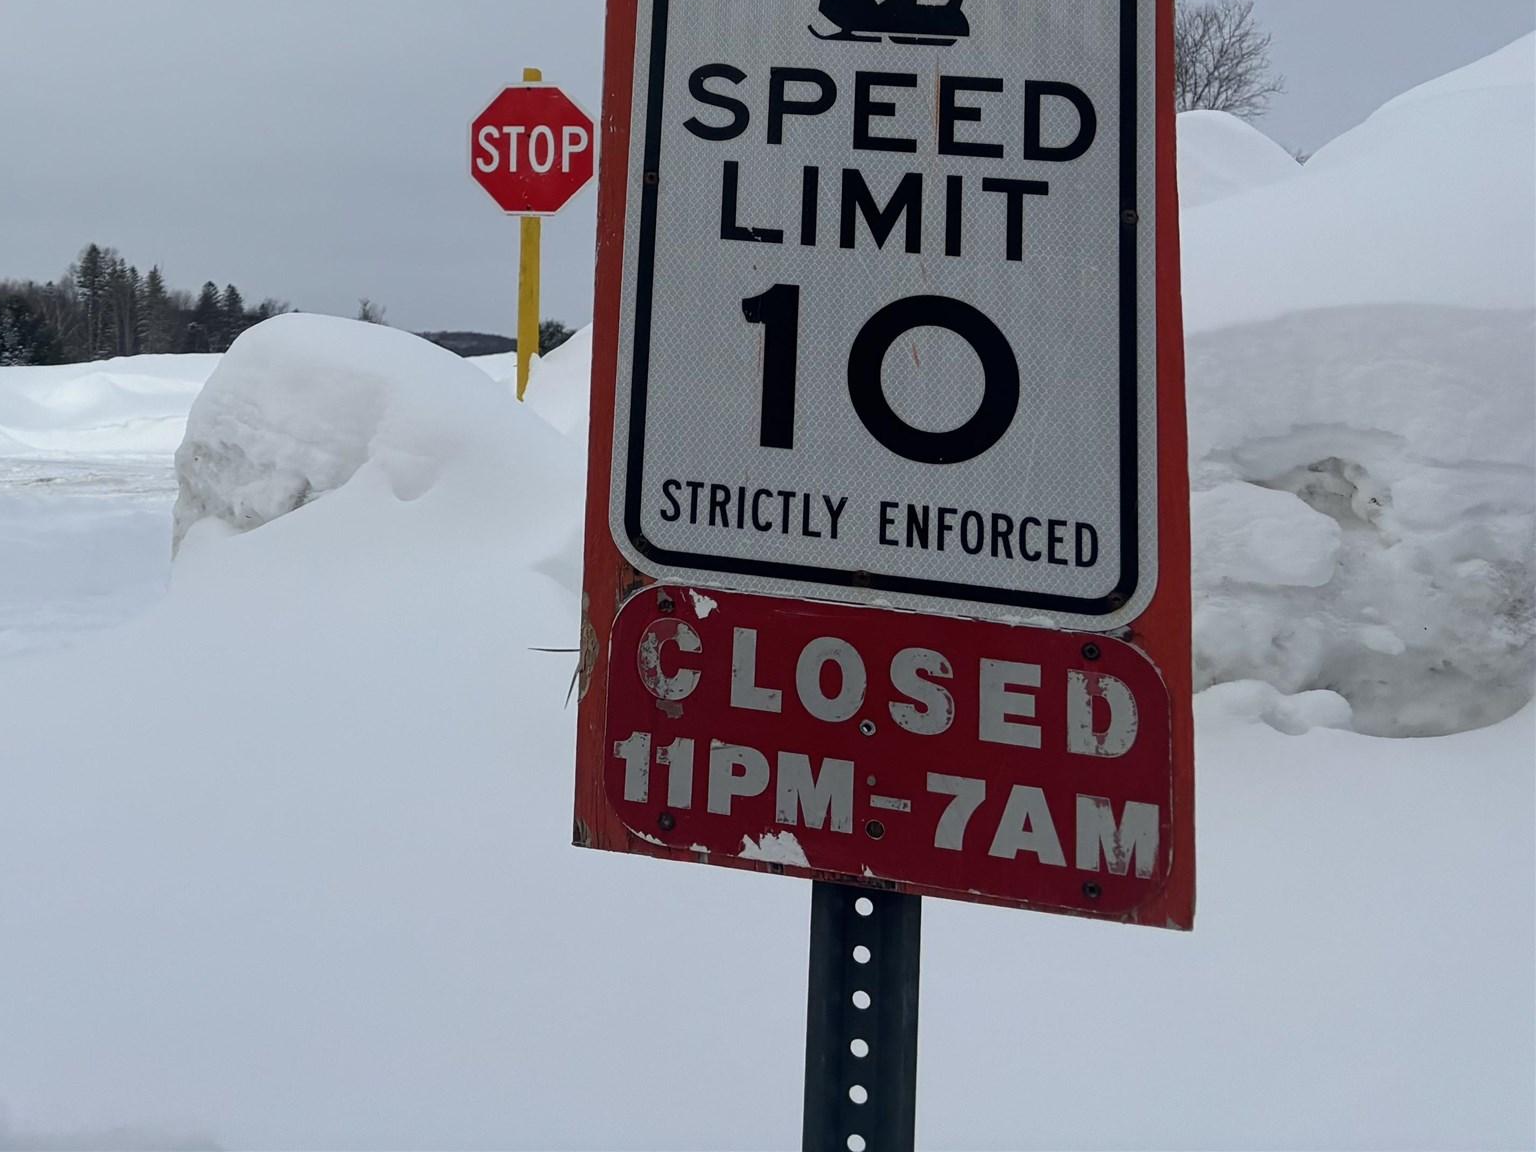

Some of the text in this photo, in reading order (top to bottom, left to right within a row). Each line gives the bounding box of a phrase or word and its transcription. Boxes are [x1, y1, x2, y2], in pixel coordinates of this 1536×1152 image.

[476, 125, 589, 173] STOP
[682, 63, 1098, 163] SPEED
[720, 160, 1049, 261] LIMIT
[741, 283, 1021, 465] 10
[659, 478, 1100, 568] STRICTLY ENFORCED
[637, 618, 1140, 758] CLOSED
